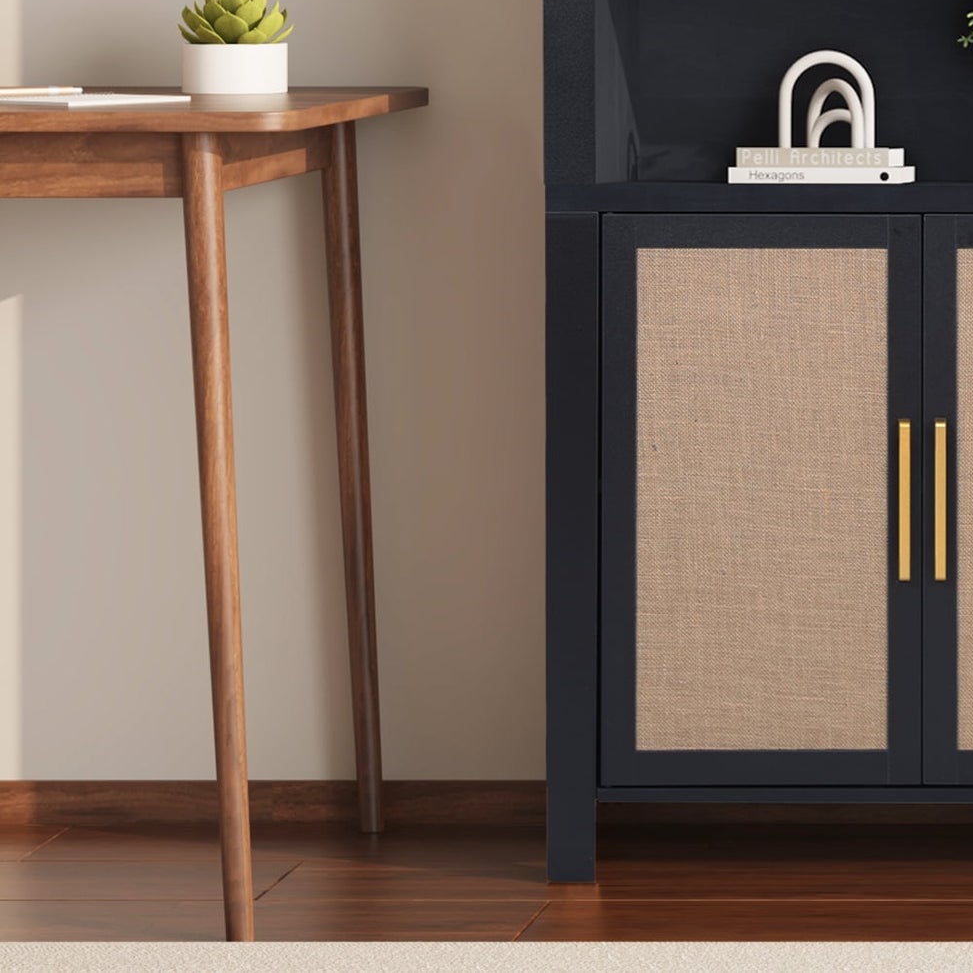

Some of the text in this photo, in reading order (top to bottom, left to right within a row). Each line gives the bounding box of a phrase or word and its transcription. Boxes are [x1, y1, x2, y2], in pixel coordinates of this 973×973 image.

[741, 149, 882, 165] Pelli Architects
[748, 170, 805, 182] Hexagons
